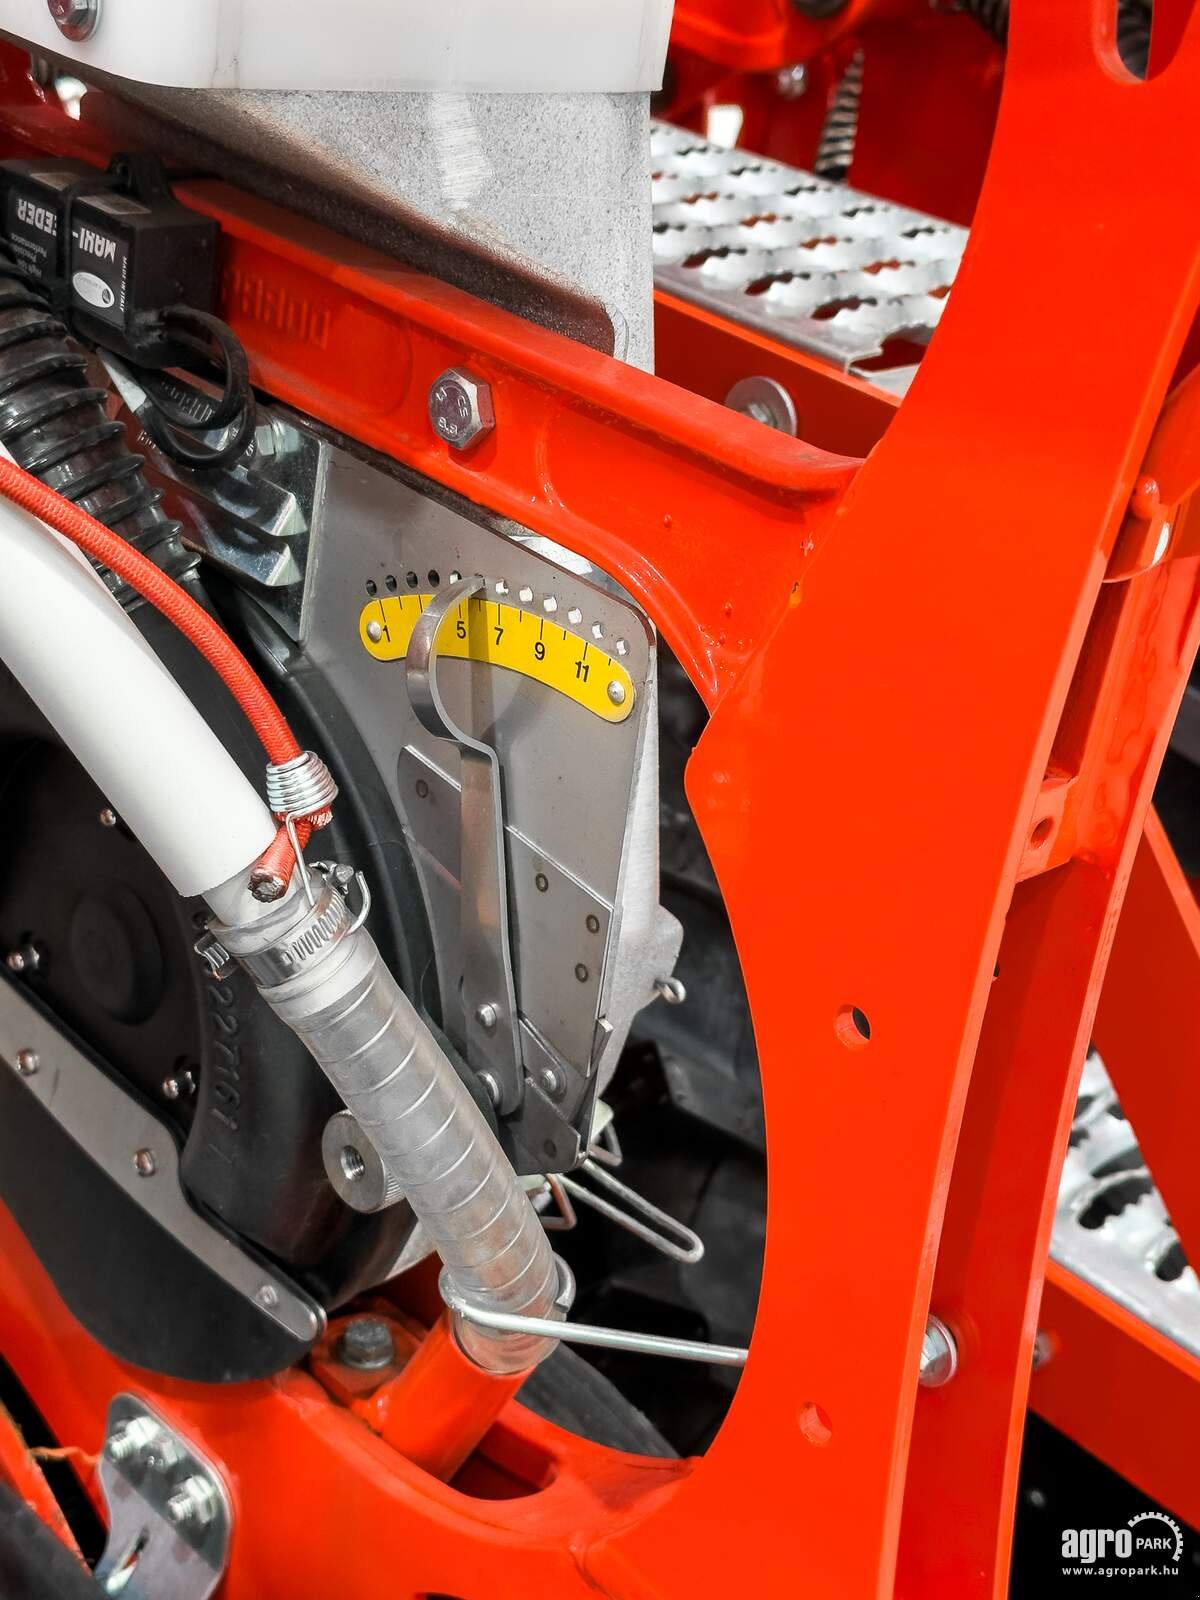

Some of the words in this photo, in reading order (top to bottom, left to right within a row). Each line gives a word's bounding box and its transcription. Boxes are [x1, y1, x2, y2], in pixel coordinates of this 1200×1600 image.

[382, 625, 391, 642] 1
[456, 621, 467, 639] 5
[493, 626, 504, 645] 7
[534, 642, 545, 660] 9
[575, 660, 590, 682] 11
